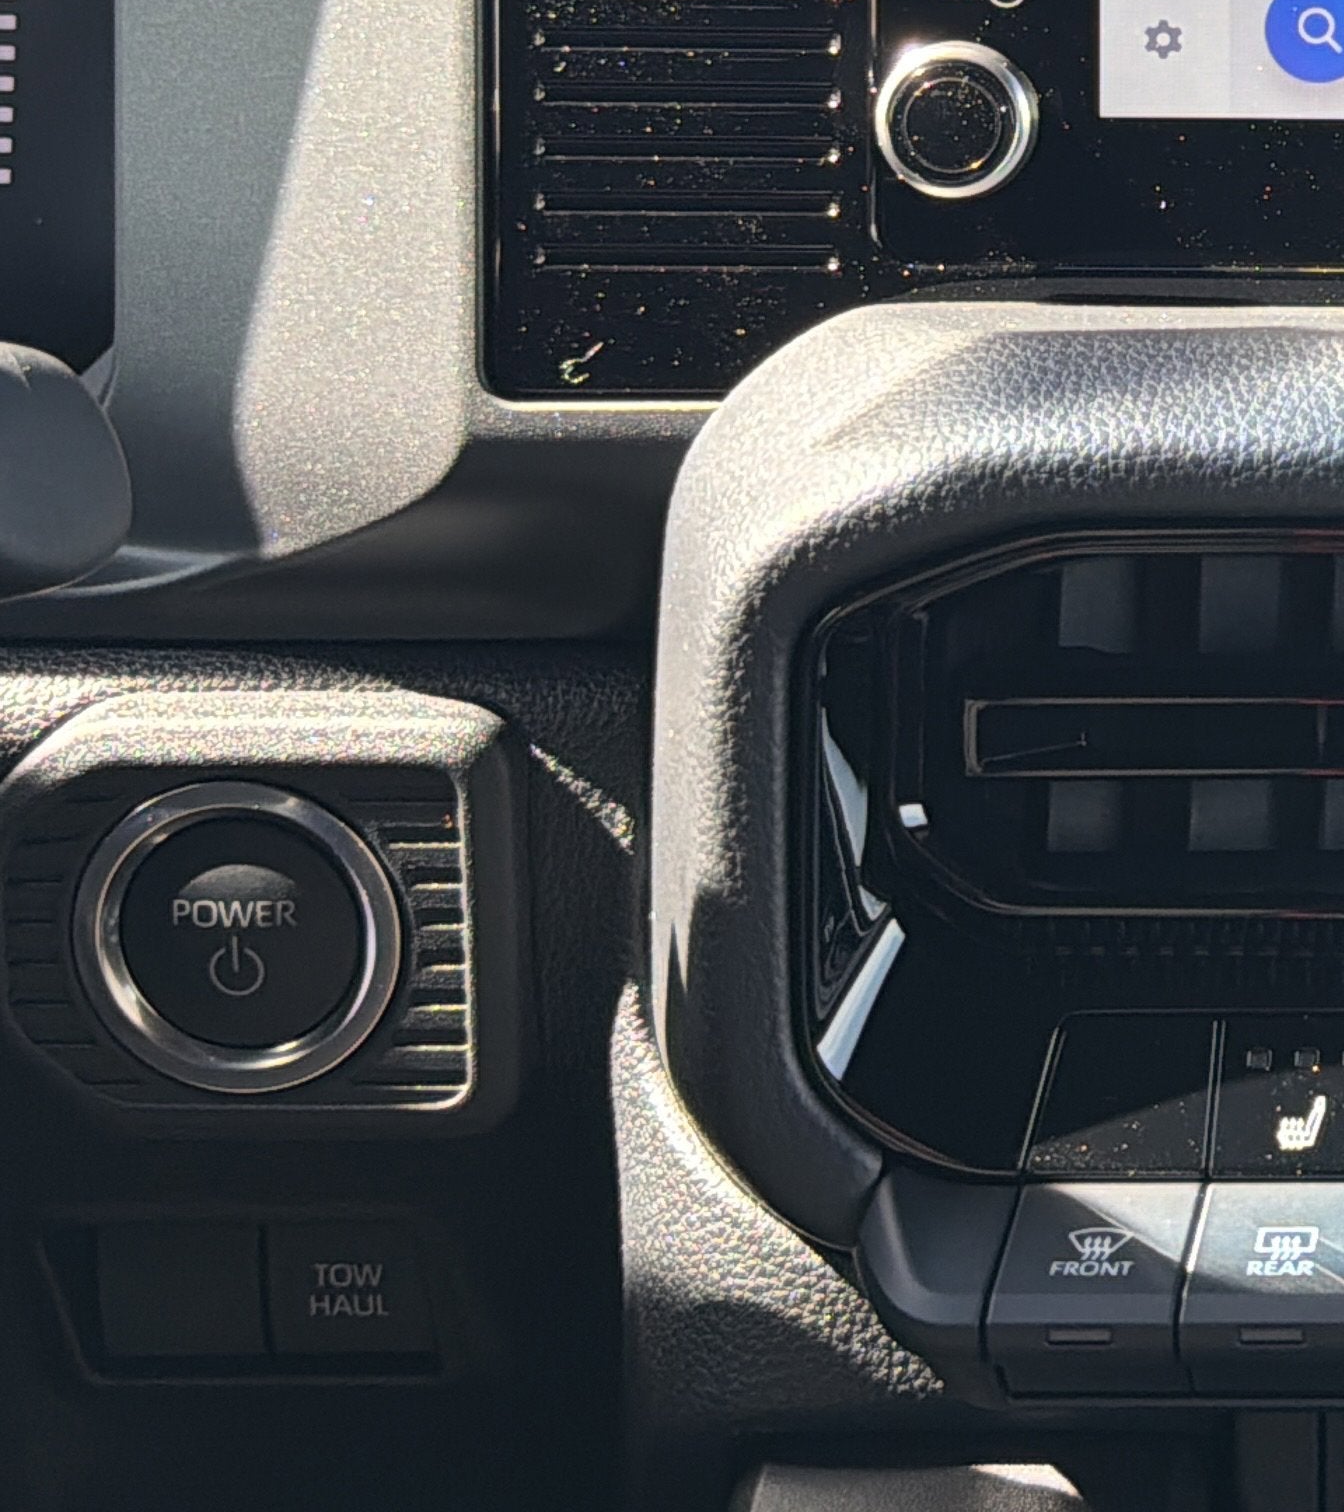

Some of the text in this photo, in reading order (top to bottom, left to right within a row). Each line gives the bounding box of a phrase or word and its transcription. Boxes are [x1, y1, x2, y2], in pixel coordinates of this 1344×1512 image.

[172, 899, 297, 928] POWER
[315, 1262, 382, 1287] TOW
[1048, 1260, 1134, 1278] FRONT
[1246, 1260, 1315, 1278] REAR
[309, 1293, 388, 1317] HAUL
